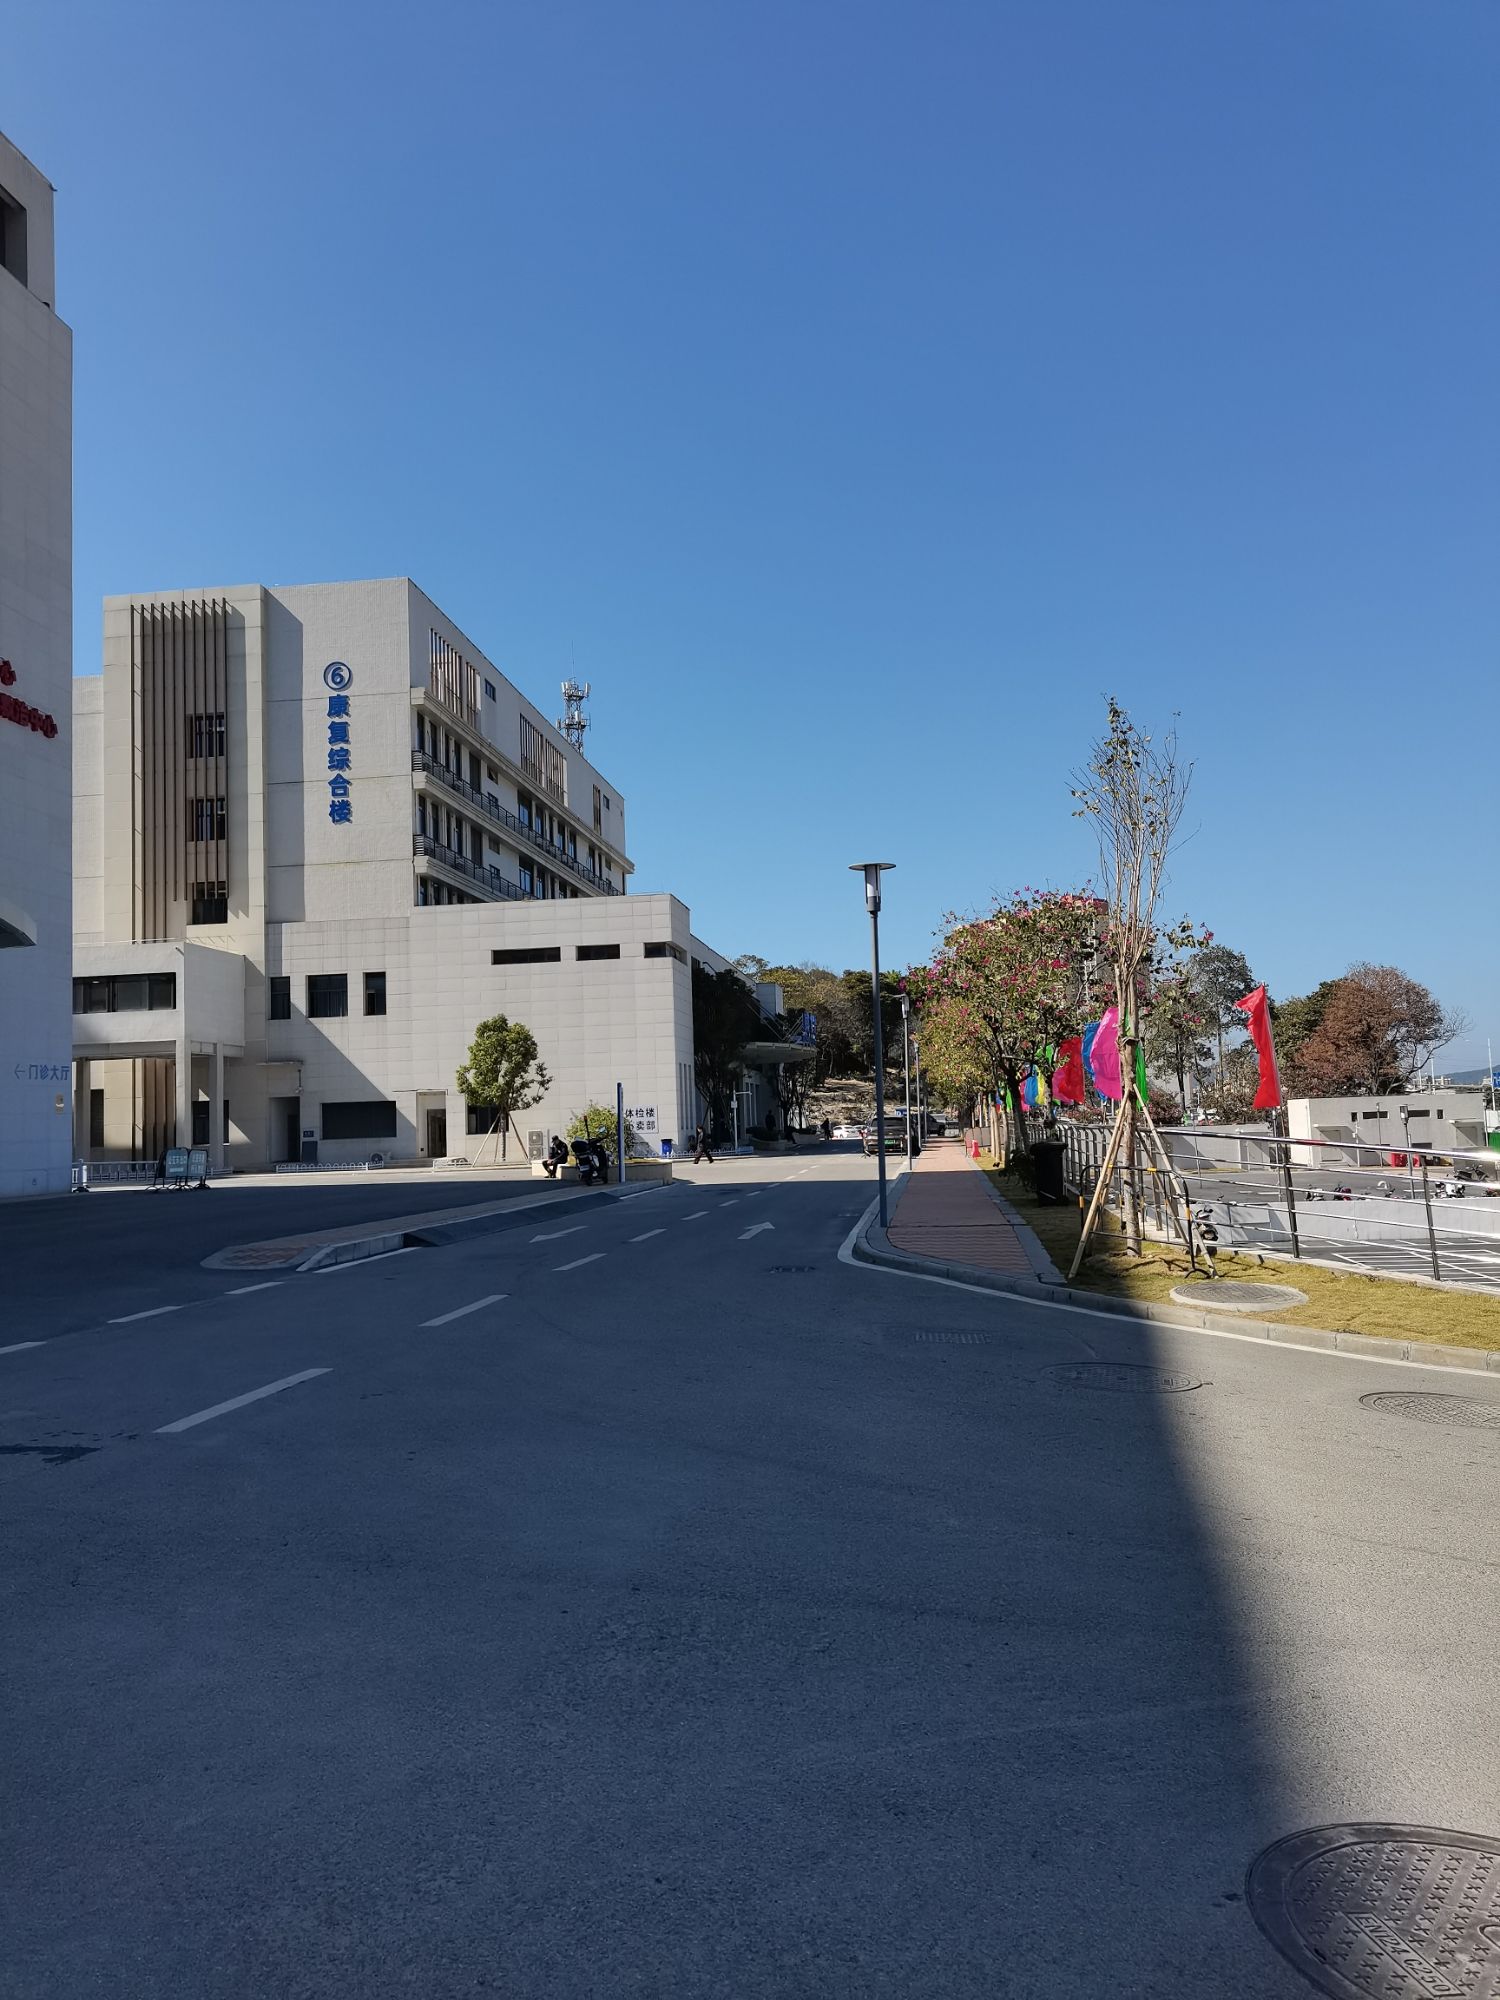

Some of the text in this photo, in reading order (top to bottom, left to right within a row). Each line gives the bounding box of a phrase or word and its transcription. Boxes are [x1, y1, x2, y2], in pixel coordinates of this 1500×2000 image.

[327, 694, 352, 825] 康复综合楼
[29, 1064, 70, 1080] 门诊大厅
[625, 1107, 655, 1118] 体检楼
[1354, 1915, 1451, 1992] EN124 C250
